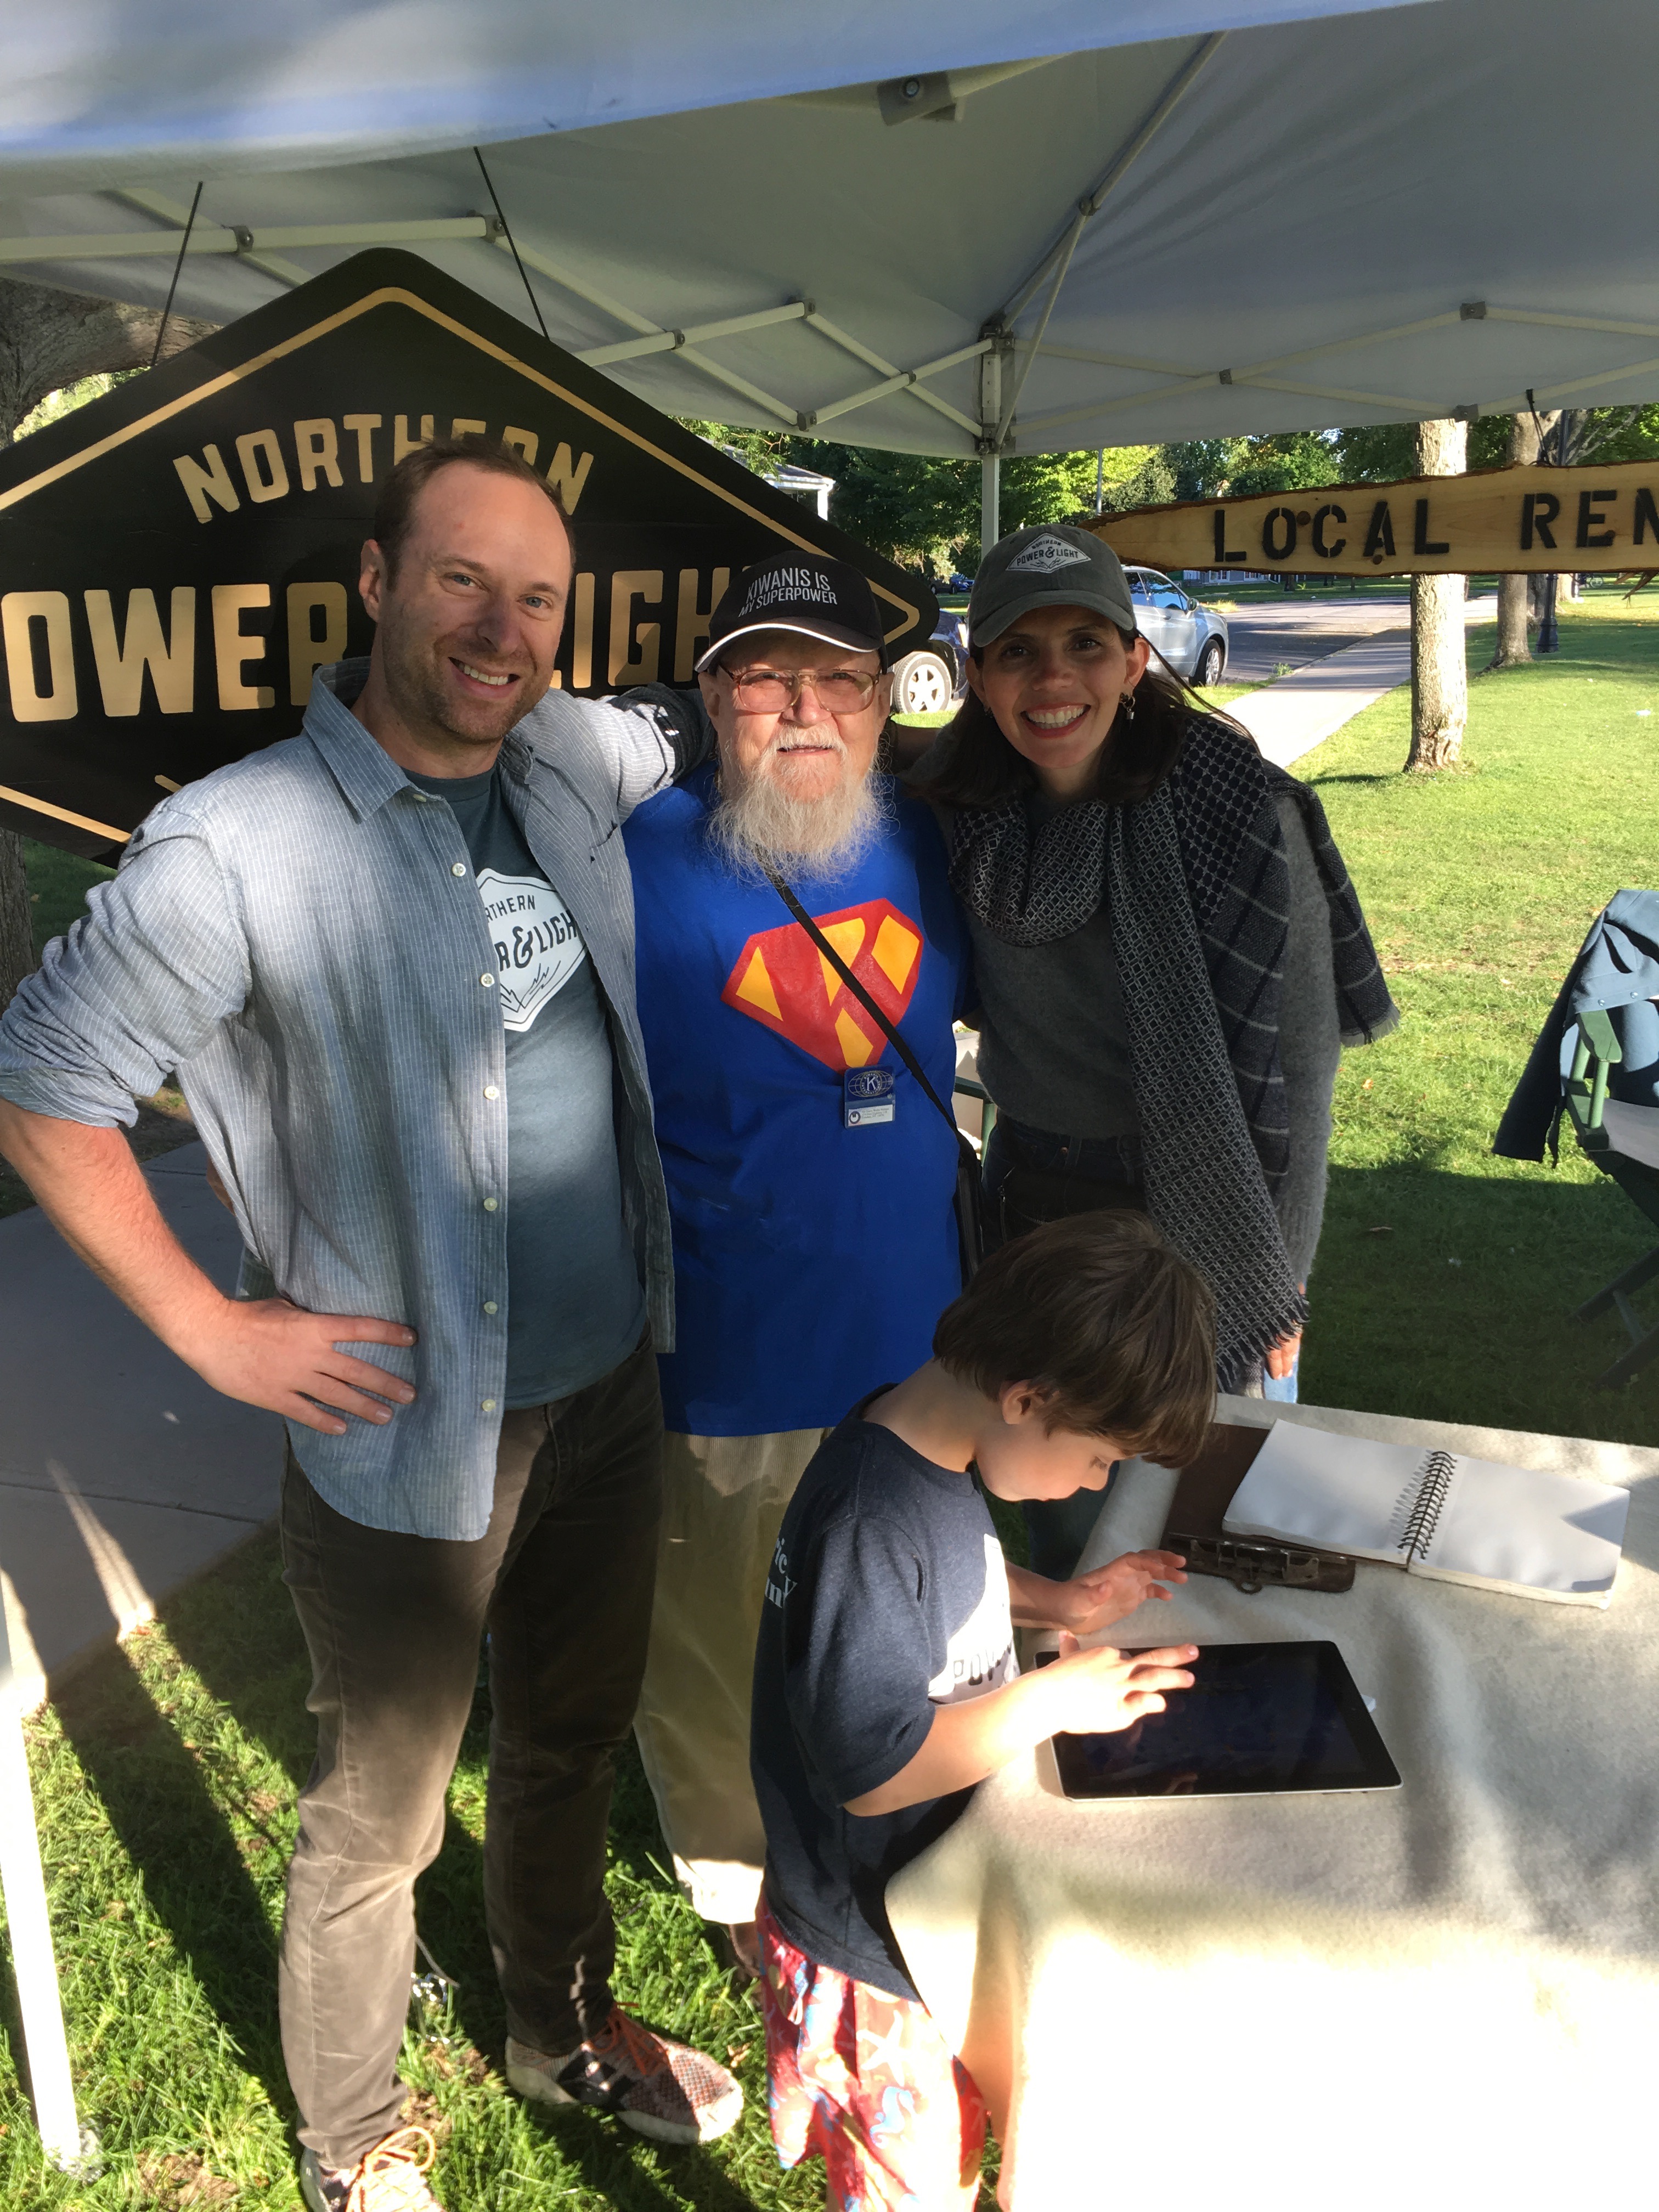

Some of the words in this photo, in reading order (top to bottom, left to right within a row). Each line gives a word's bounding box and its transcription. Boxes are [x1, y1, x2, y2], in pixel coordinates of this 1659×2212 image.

[1031, 539, 1062, 549] NORTHERN
[1214, 498, 1450, 562] LOCAL
[1017, 549, 1044, 566] POWER
[1045, 546, 1055, 558] &
[1056, 549, 1079, 558] LIGHT
[746, 567, 811, 604] KIWANIS
[815, 571, 831, 591] IS
[738, 599, 755, 617] MY
[756, 587, 838, 610] SUPERPOWER
[512, 926, 533, 969] &
[866, 1076, 876, 1092] K
